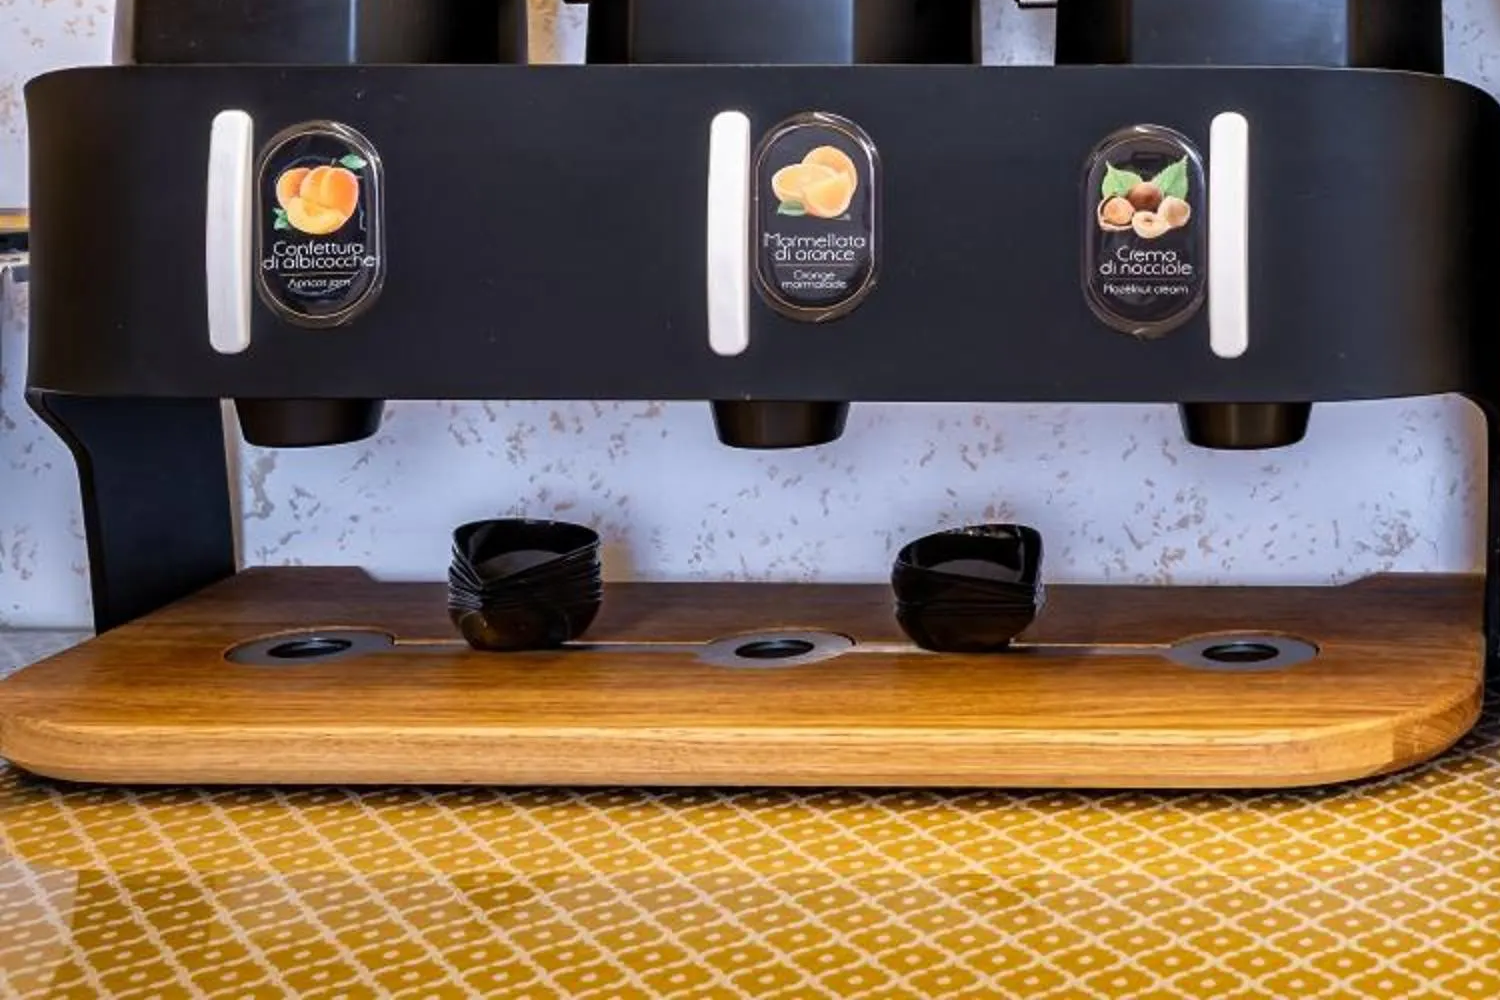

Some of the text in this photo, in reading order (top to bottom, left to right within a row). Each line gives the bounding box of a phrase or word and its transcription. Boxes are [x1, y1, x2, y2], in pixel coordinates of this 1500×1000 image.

[273, 240, 364, 256] Confettura
[763, 232, 866, 248] Marmellata
[775, 245, 855, 261] di arance
[1117, 245, 1177, 262] Crema
[263, 254, 376, 270] di albicocche
[1100, 260, 1193, 275] di nocciole
